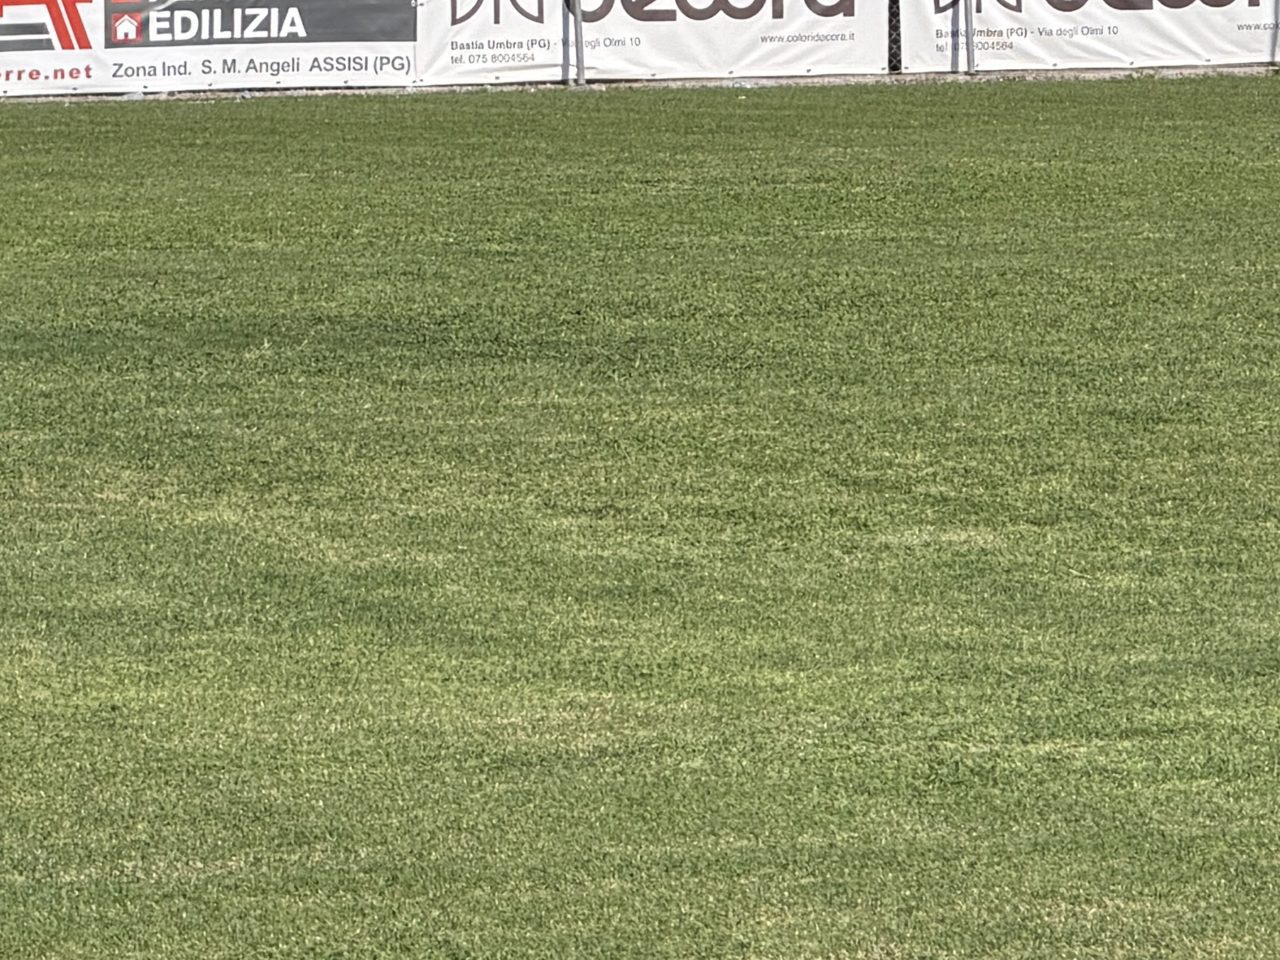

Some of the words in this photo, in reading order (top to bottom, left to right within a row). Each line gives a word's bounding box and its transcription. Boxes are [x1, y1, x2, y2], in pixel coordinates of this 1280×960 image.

[148, 7, 307, 42] EDILIZIA
[1006, 27, 1028, 39] (PG)
[1107, 25, 1119, 36] 10
[630, 37, 641, 47] 10
[112, 62, 157, 78] Zona
[161, 61, 191, 77] Ind.
[201, 59, 217, 75] S.
[222, 58, 241, 74] M.
[245, 57, 300, 77] Angeli
[309, 56, 369, 73] ASSISI
[373, 55, 412, 75] (PG)
[468, 54, 488, 64] 075
[0, 64, 92, 81] rre.net
